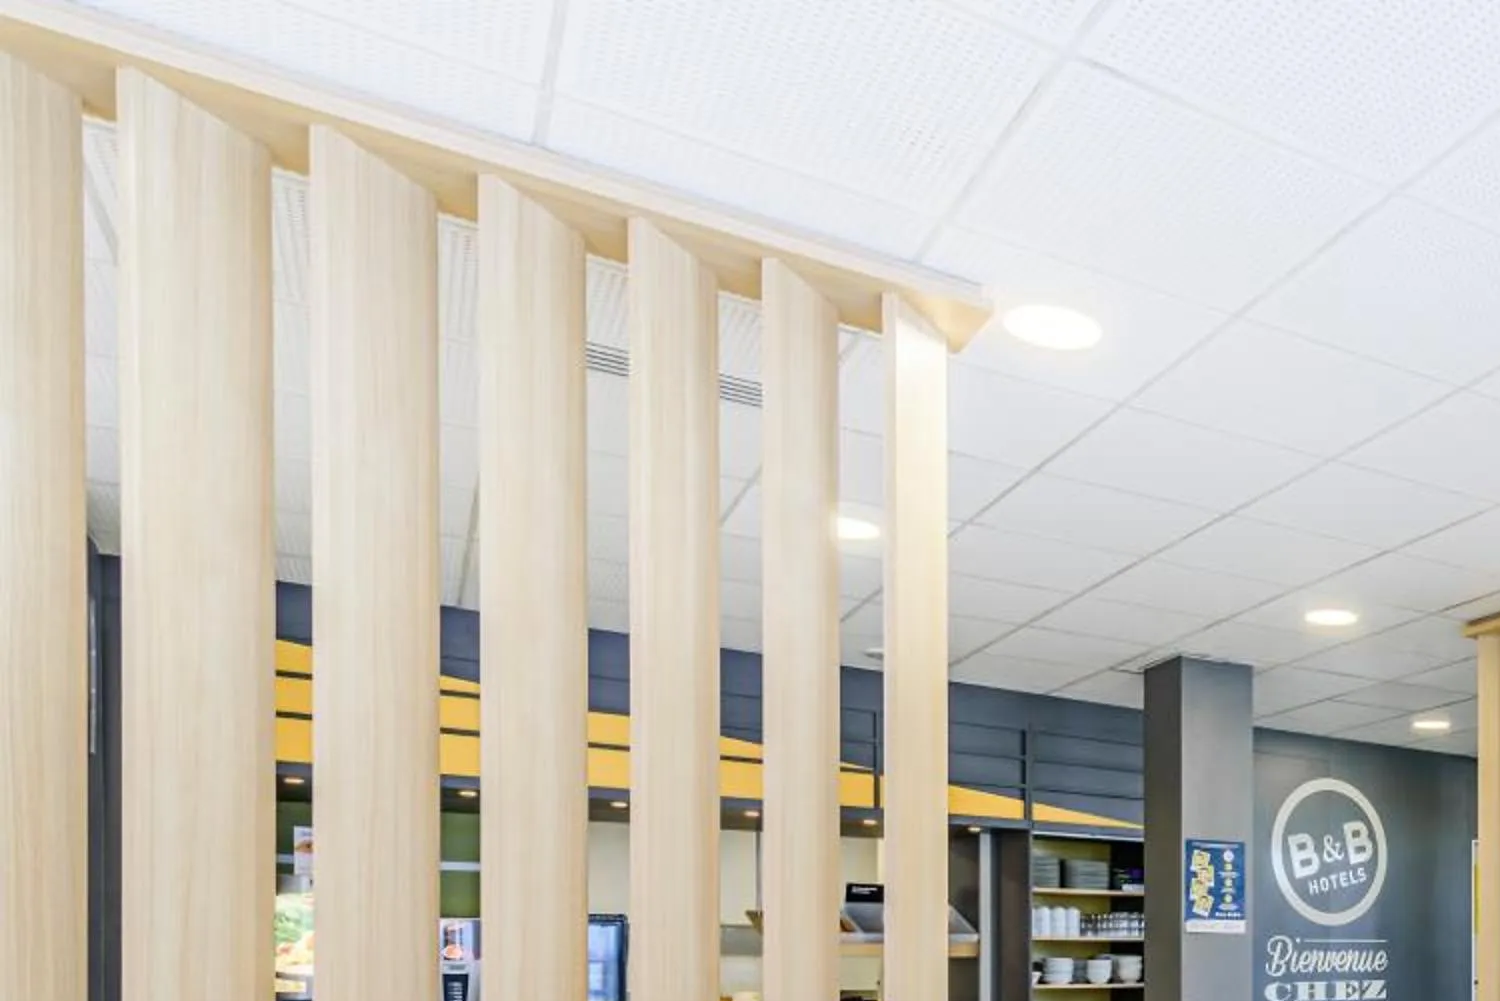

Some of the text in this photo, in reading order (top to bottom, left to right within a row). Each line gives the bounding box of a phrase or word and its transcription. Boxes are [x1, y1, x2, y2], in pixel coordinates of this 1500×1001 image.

[1287, 821, 1373, 879] B&B
[1308, 867, 1368, 895] HOTELS
[1265, 935, 1389, 977] Bienvenue
